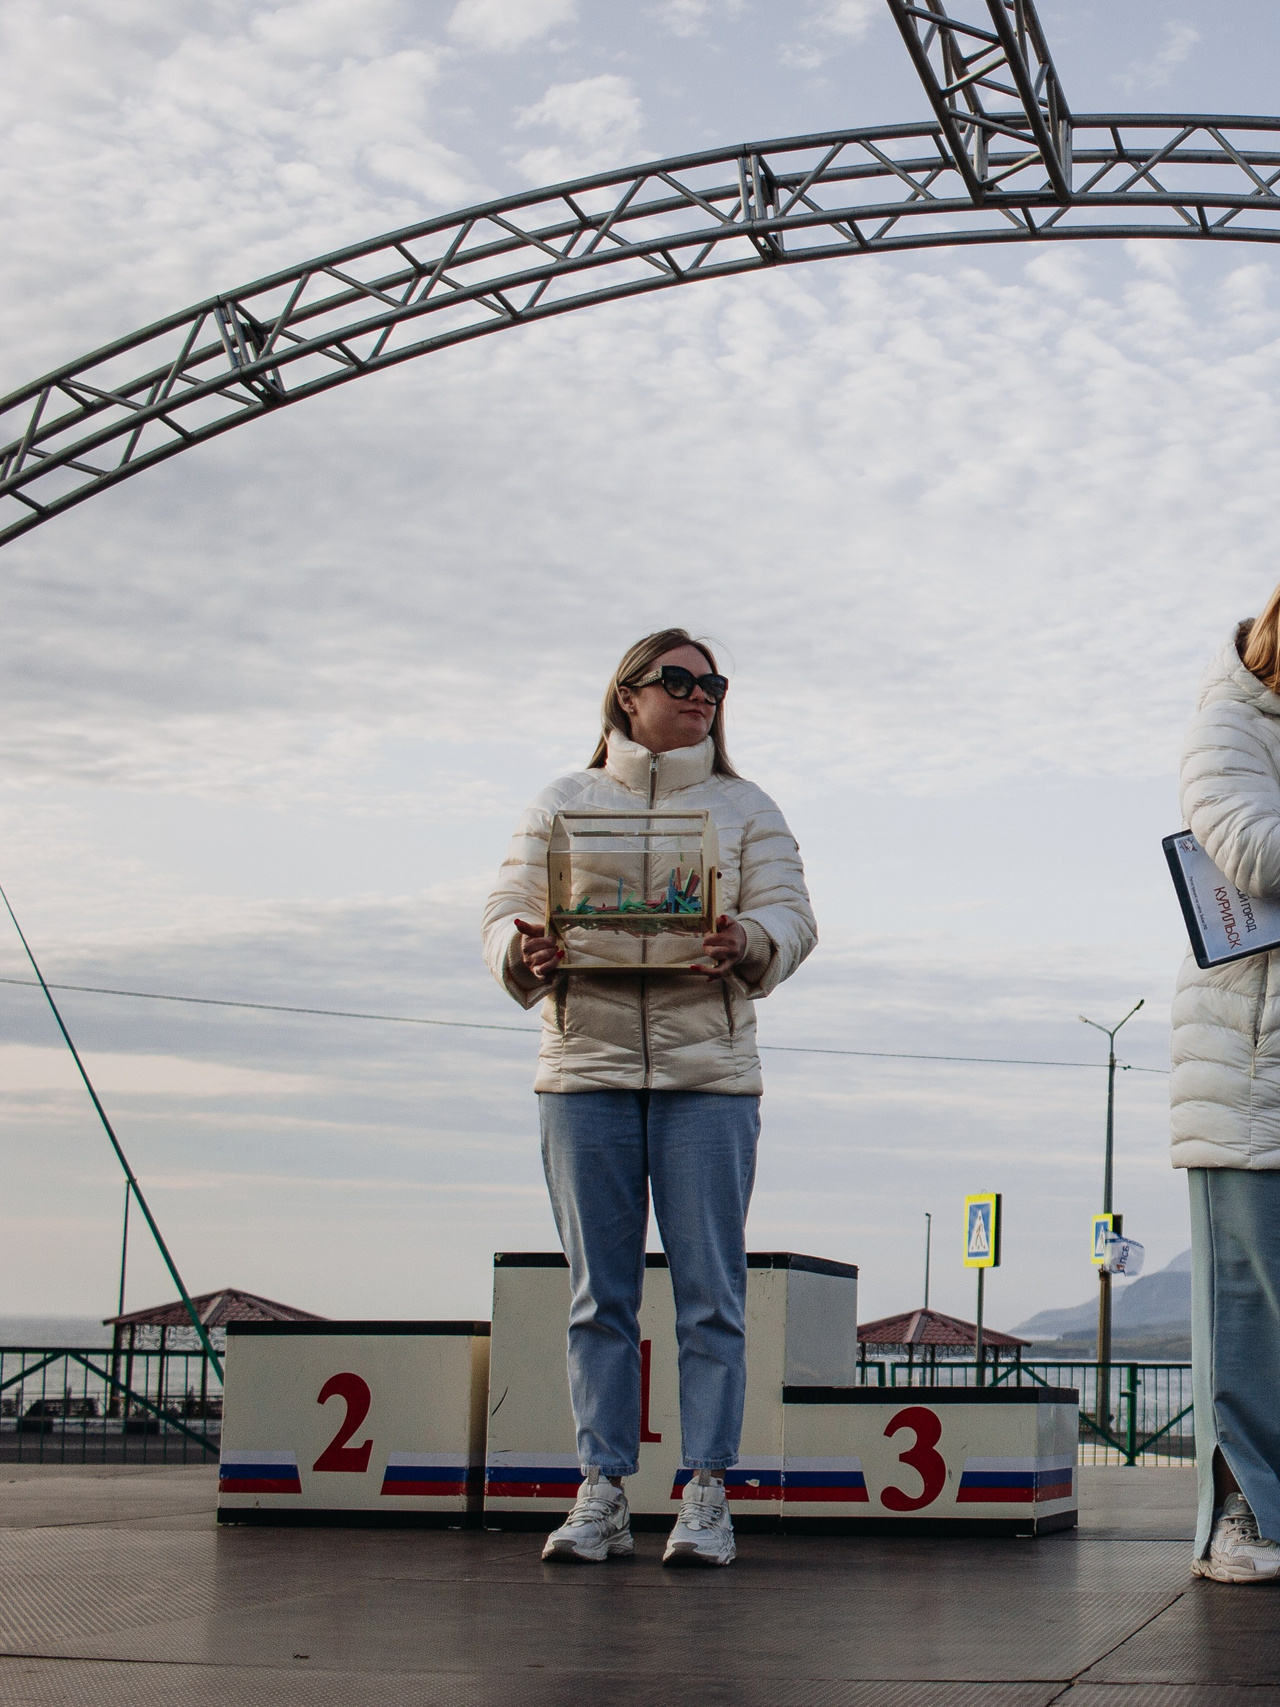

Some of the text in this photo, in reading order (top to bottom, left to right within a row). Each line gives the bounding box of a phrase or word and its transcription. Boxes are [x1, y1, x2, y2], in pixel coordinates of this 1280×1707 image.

[1213, 886, 1242, 949] КУРИЛЬСК
[1241, 902, 1258, 933] ГОРОД
[1120, 1245, 1129, 1264] ПСБ
[312, 1372, 374, 1472] 2
[881, 1406, 946, 1512] 3
